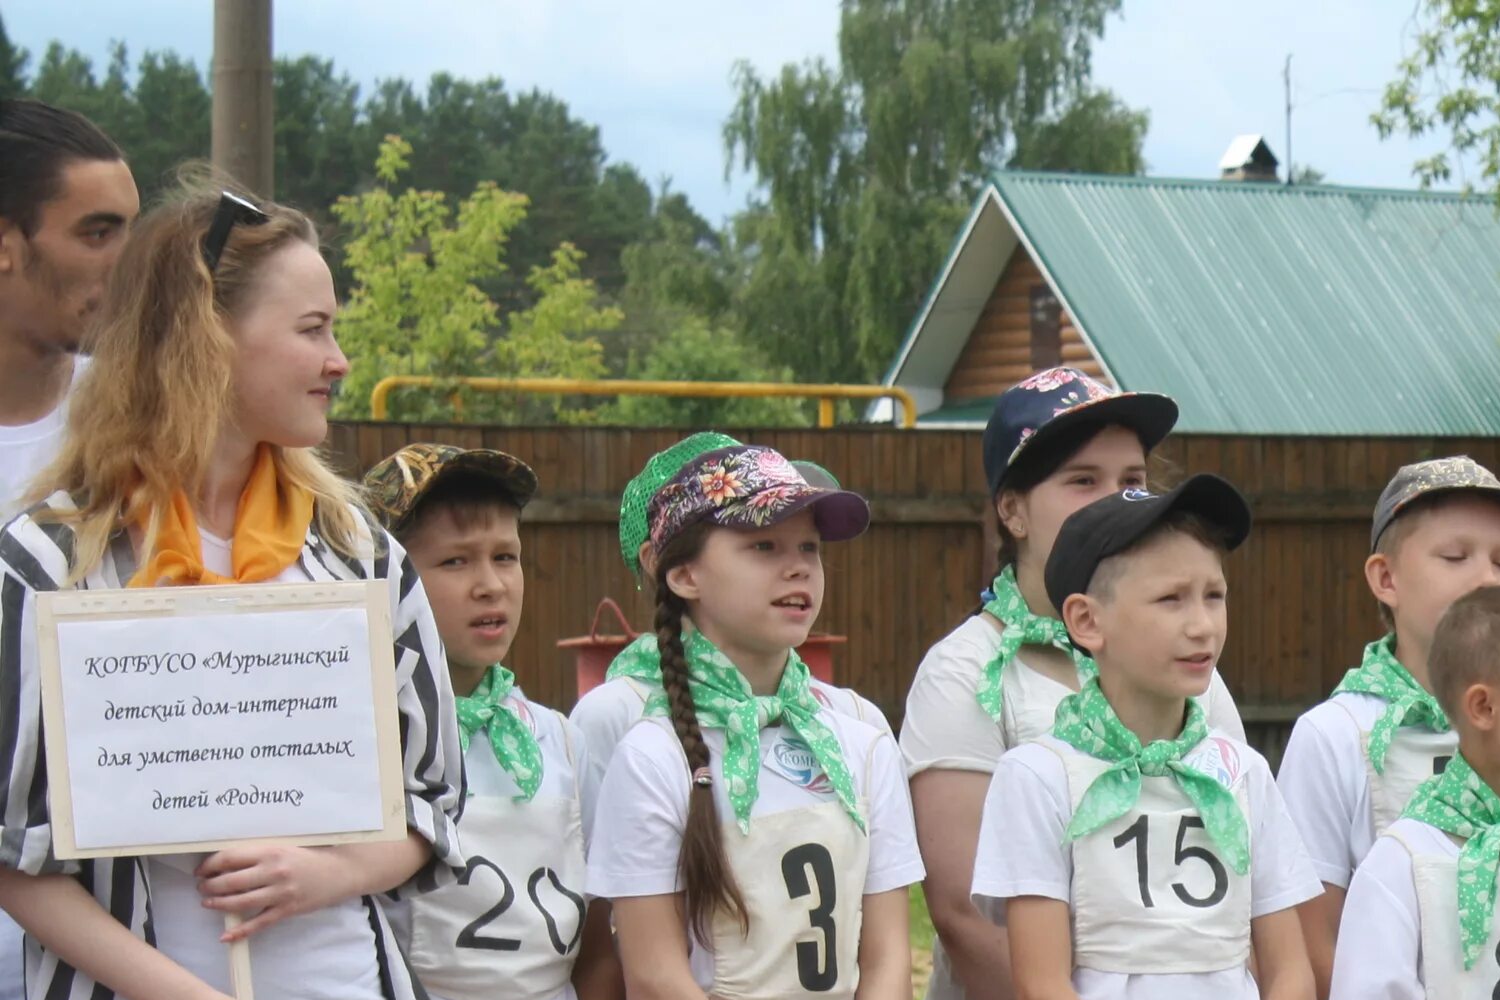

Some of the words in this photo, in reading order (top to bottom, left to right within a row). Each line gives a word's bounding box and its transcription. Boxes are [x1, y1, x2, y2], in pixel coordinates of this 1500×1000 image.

[84, 650, 197, 678] КОГБУСО
[202, 644, 351, 676] «Мурыгинский
[104, 698, 187, 722] детский
[191, 694, 339, 721] дом-интернат
[97, 746, 133, 768] для
[136, 744, 245, 772] умственно
[250, 737, 356, 760] отсталых
[152, 788, 210, 811] детей
[215, 785, 305, 809] «Родник»
[1113, 814, 1229, 908] 15
[455, 855, 587, 956] 20
[781, 842, 838, 992] 3
